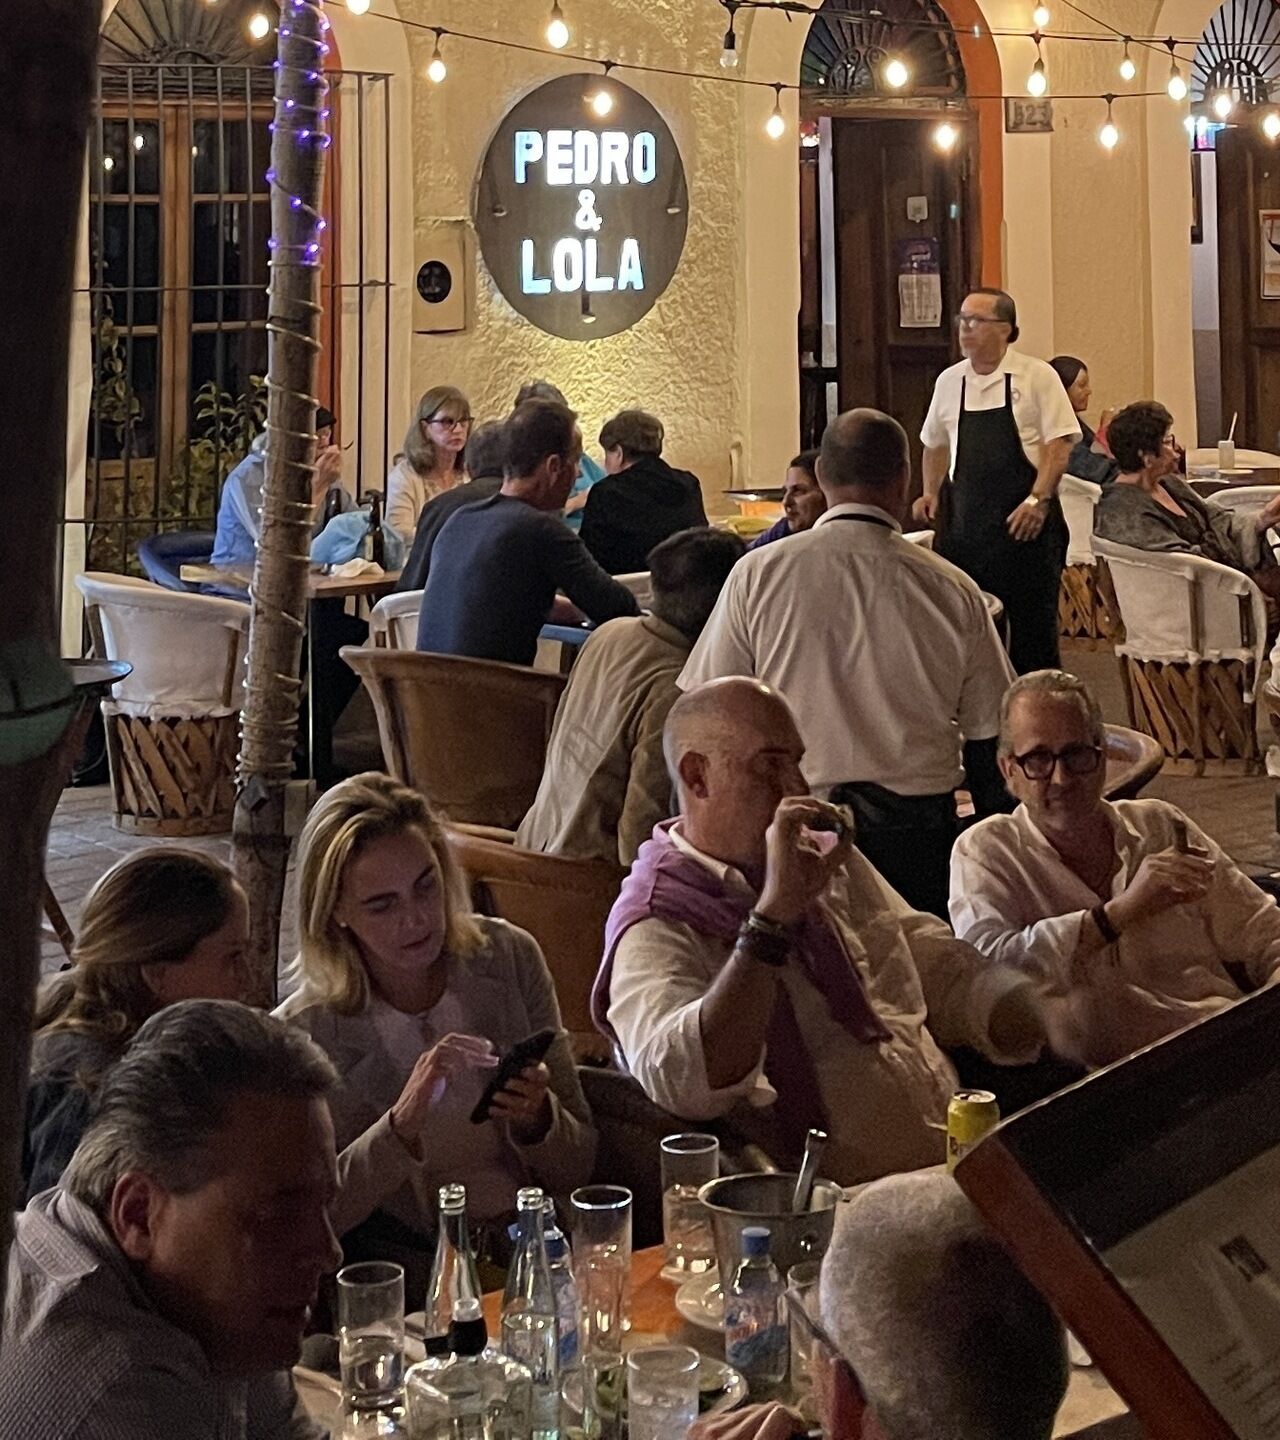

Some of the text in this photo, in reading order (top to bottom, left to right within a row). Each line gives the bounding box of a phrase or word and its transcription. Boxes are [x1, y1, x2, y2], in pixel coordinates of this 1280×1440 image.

[513, 128, 657, 186] PEDRO
[573, 188, 604, 232] &
[520, 238, 644, 296] LOLA
